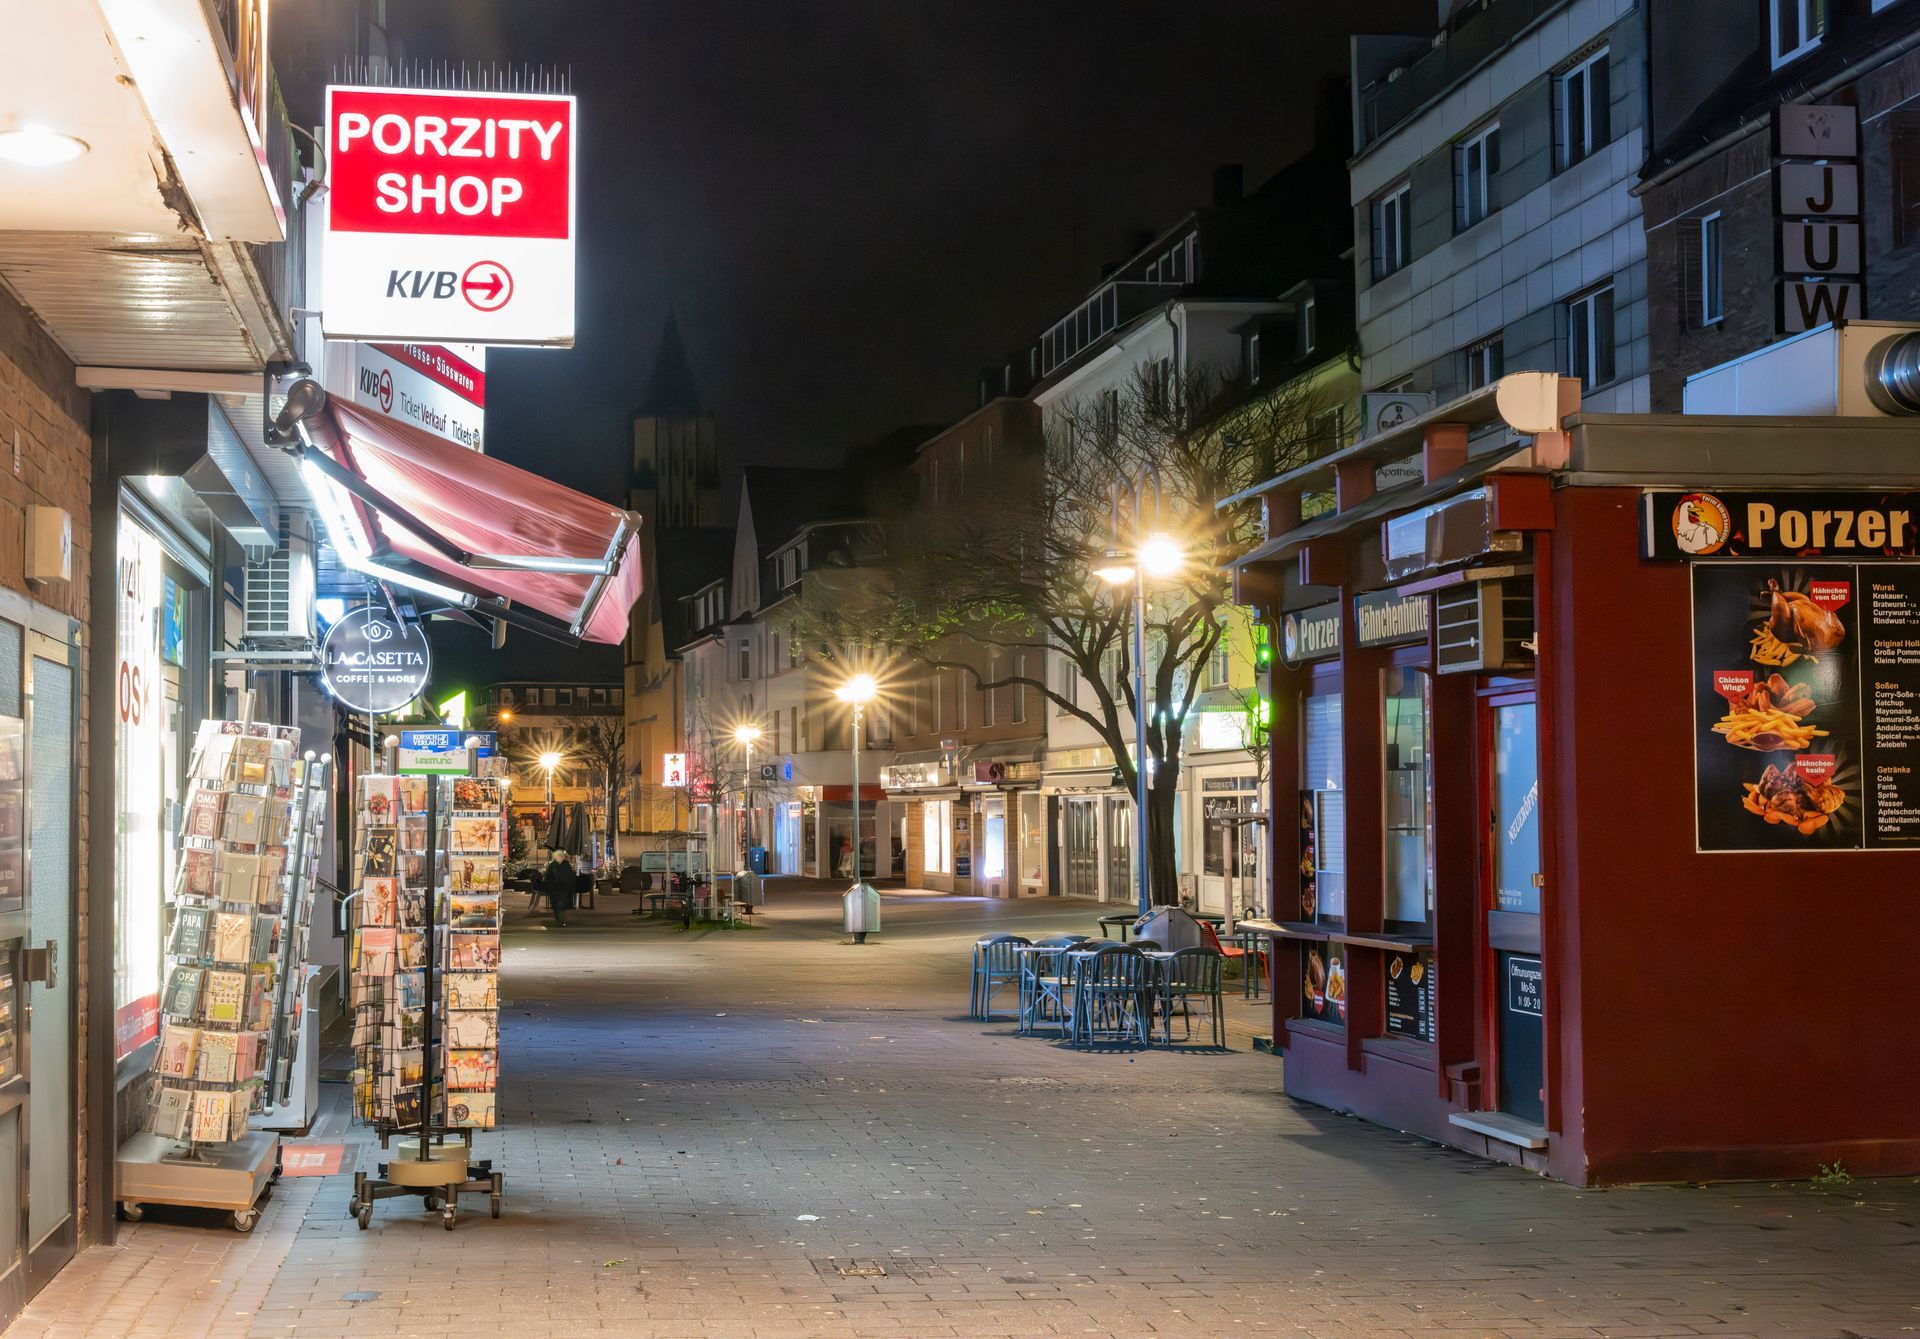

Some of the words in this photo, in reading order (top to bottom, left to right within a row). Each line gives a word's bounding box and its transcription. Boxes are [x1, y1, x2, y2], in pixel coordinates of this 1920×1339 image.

[339, 112, 562, 160] PORZITY
[376, 173, 523, 217] SHOP
[386, 270, 457, 299] KVB
[436, 356, 474, 391] Süsswaren
[360, 366, 380, 398] KVB
[400, 392, 420, 420] Ticket
[421, 403, 447, 432] Verkauf
[452, 420, 472, 446] Tickets
[1377, 467, 1422, 479] Apotheke
[1747, 502, 1910, 548] Porzer
[1812, 586, 1848, 595] Hähnchen
[1873, 609, 1911, 617] Currywurst
[1359, 596, 1429, 642] Hähnchenhütte
[1300, 616, 1338, 652] Porzer
[1874, 640, 1904, 648] Original
[329, 652, 350, 665] LA
[354, 652, 424, 665] CASETTA
[336, 675, 375, 684] COFFEE
[378, 675, 385, 684] &
[387, 675, 416, 684] MORE
[1719, 676, 1749, 684] Chicken
[1722, 684, 1746, 692] Wings
[1875, 699, 1904, 707] Ketchup
[1876, 715, 1920, 723] Samurai-Soß
[1797, 760, 1834, 768] Hähnchen-
[1805, 766, 1826, 774] keule
[1877, 765, 1911, 774] Getränke
[1877, 791, 1898, 799] Sprite
[1879, 824, 1900, 832] Kaffee
[182, 914, 201, 928] PAPA
[177, 971, 195, 982] OPA
